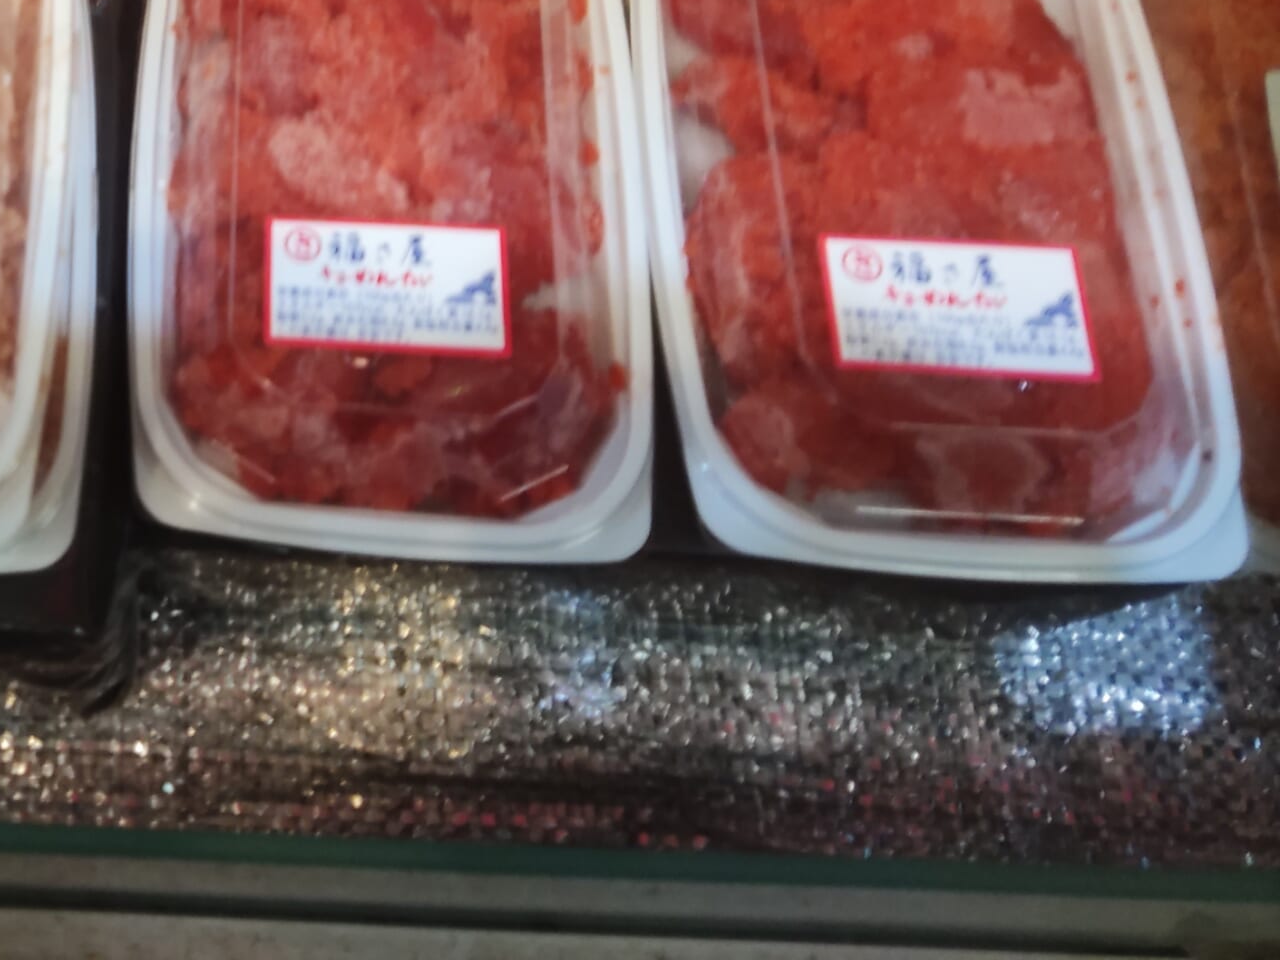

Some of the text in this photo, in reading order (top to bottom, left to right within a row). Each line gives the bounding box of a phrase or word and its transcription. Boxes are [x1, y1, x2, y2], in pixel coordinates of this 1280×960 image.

[329, 231, 433, 266] 福さ屋
[890, 250, 1005, 288] 福さ屋
